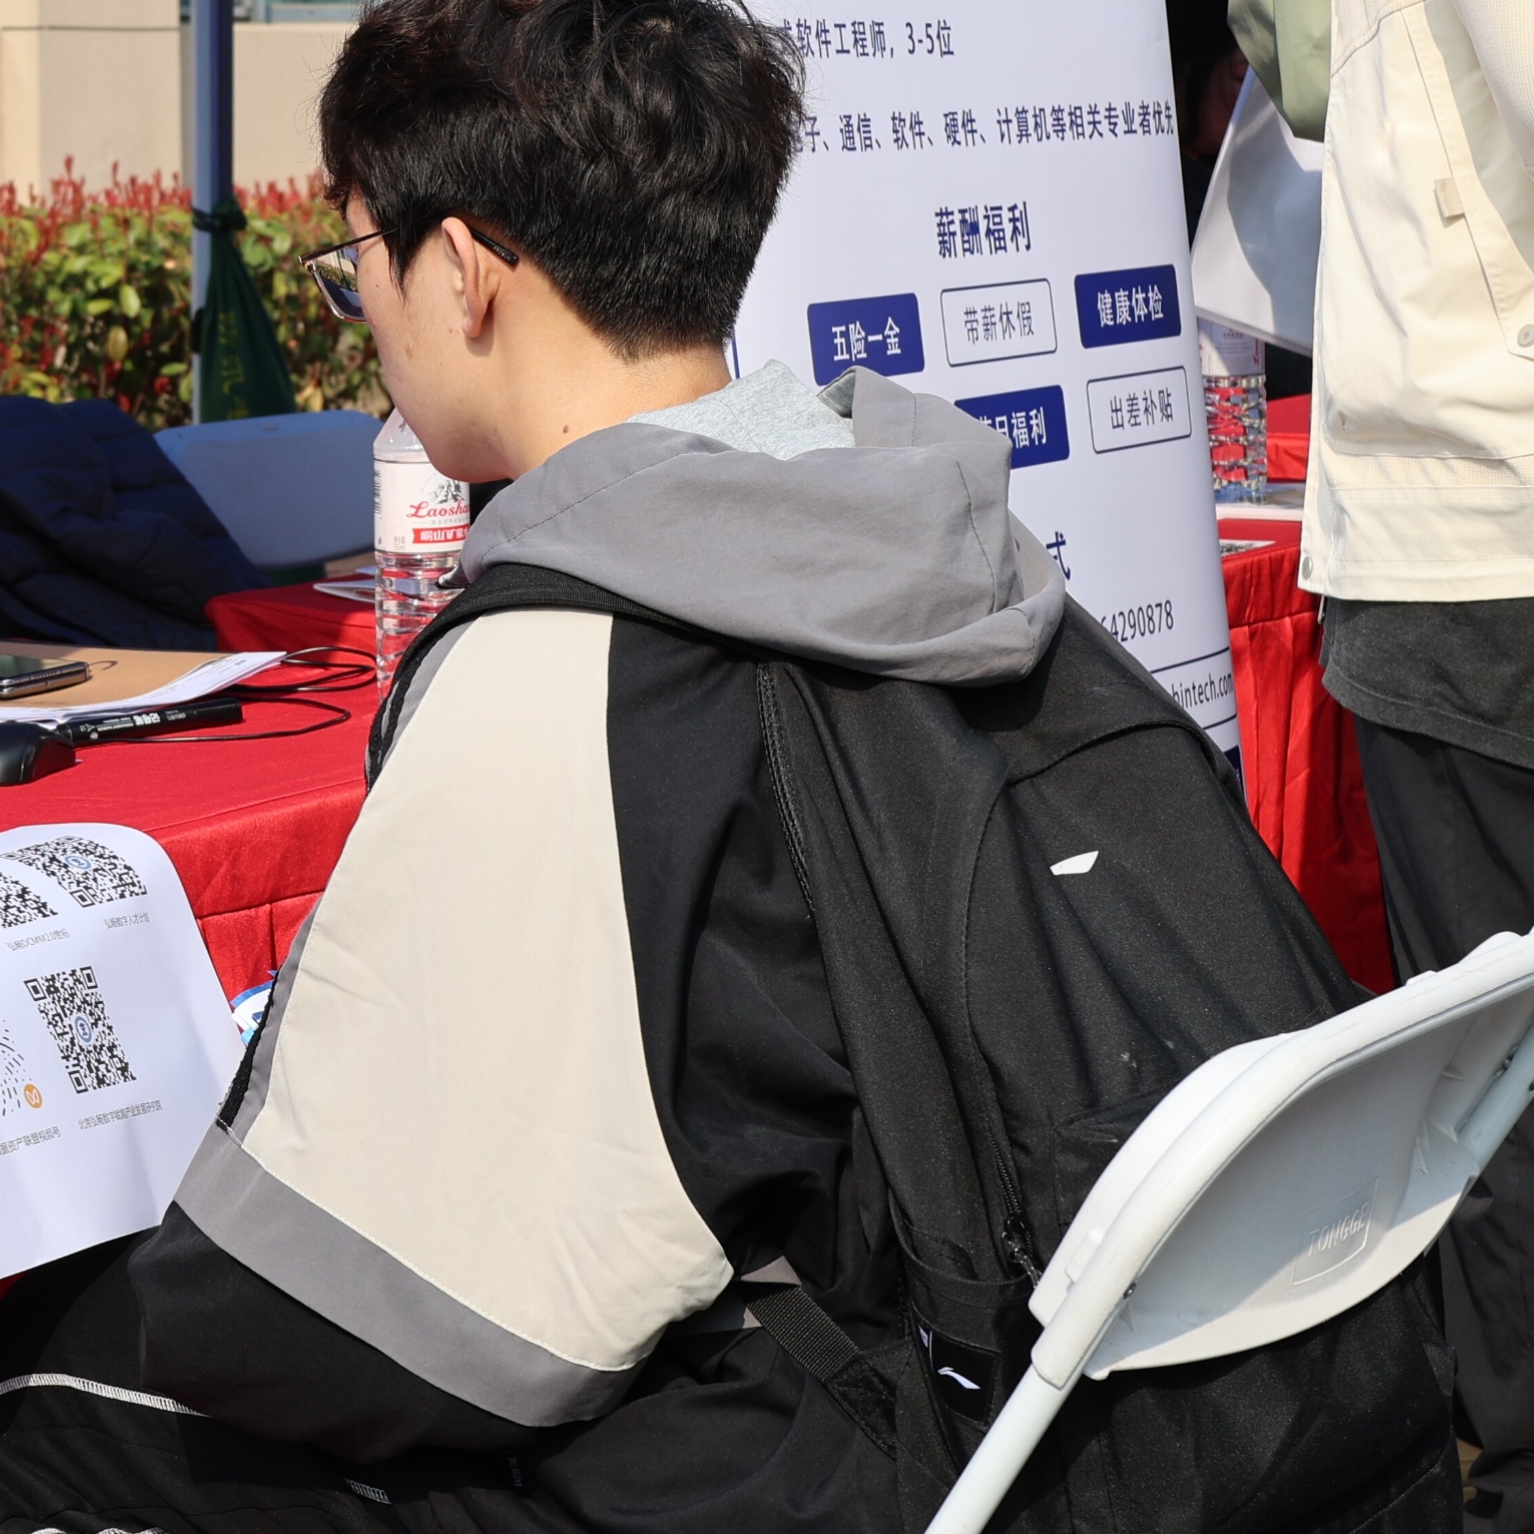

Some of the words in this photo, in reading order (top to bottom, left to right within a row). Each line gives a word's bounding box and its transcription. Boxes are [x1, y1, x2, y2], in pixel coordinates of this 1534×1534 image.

[934, 200, 1033, 260] 薪酬福利
[962, 299, 1035, 346] 带薪休假
[1096, 285, 1166, 329] 健康体检
[831, 316, 903, 363] 五险一金
[1108, 385, 1176, 432] 出差补贴
